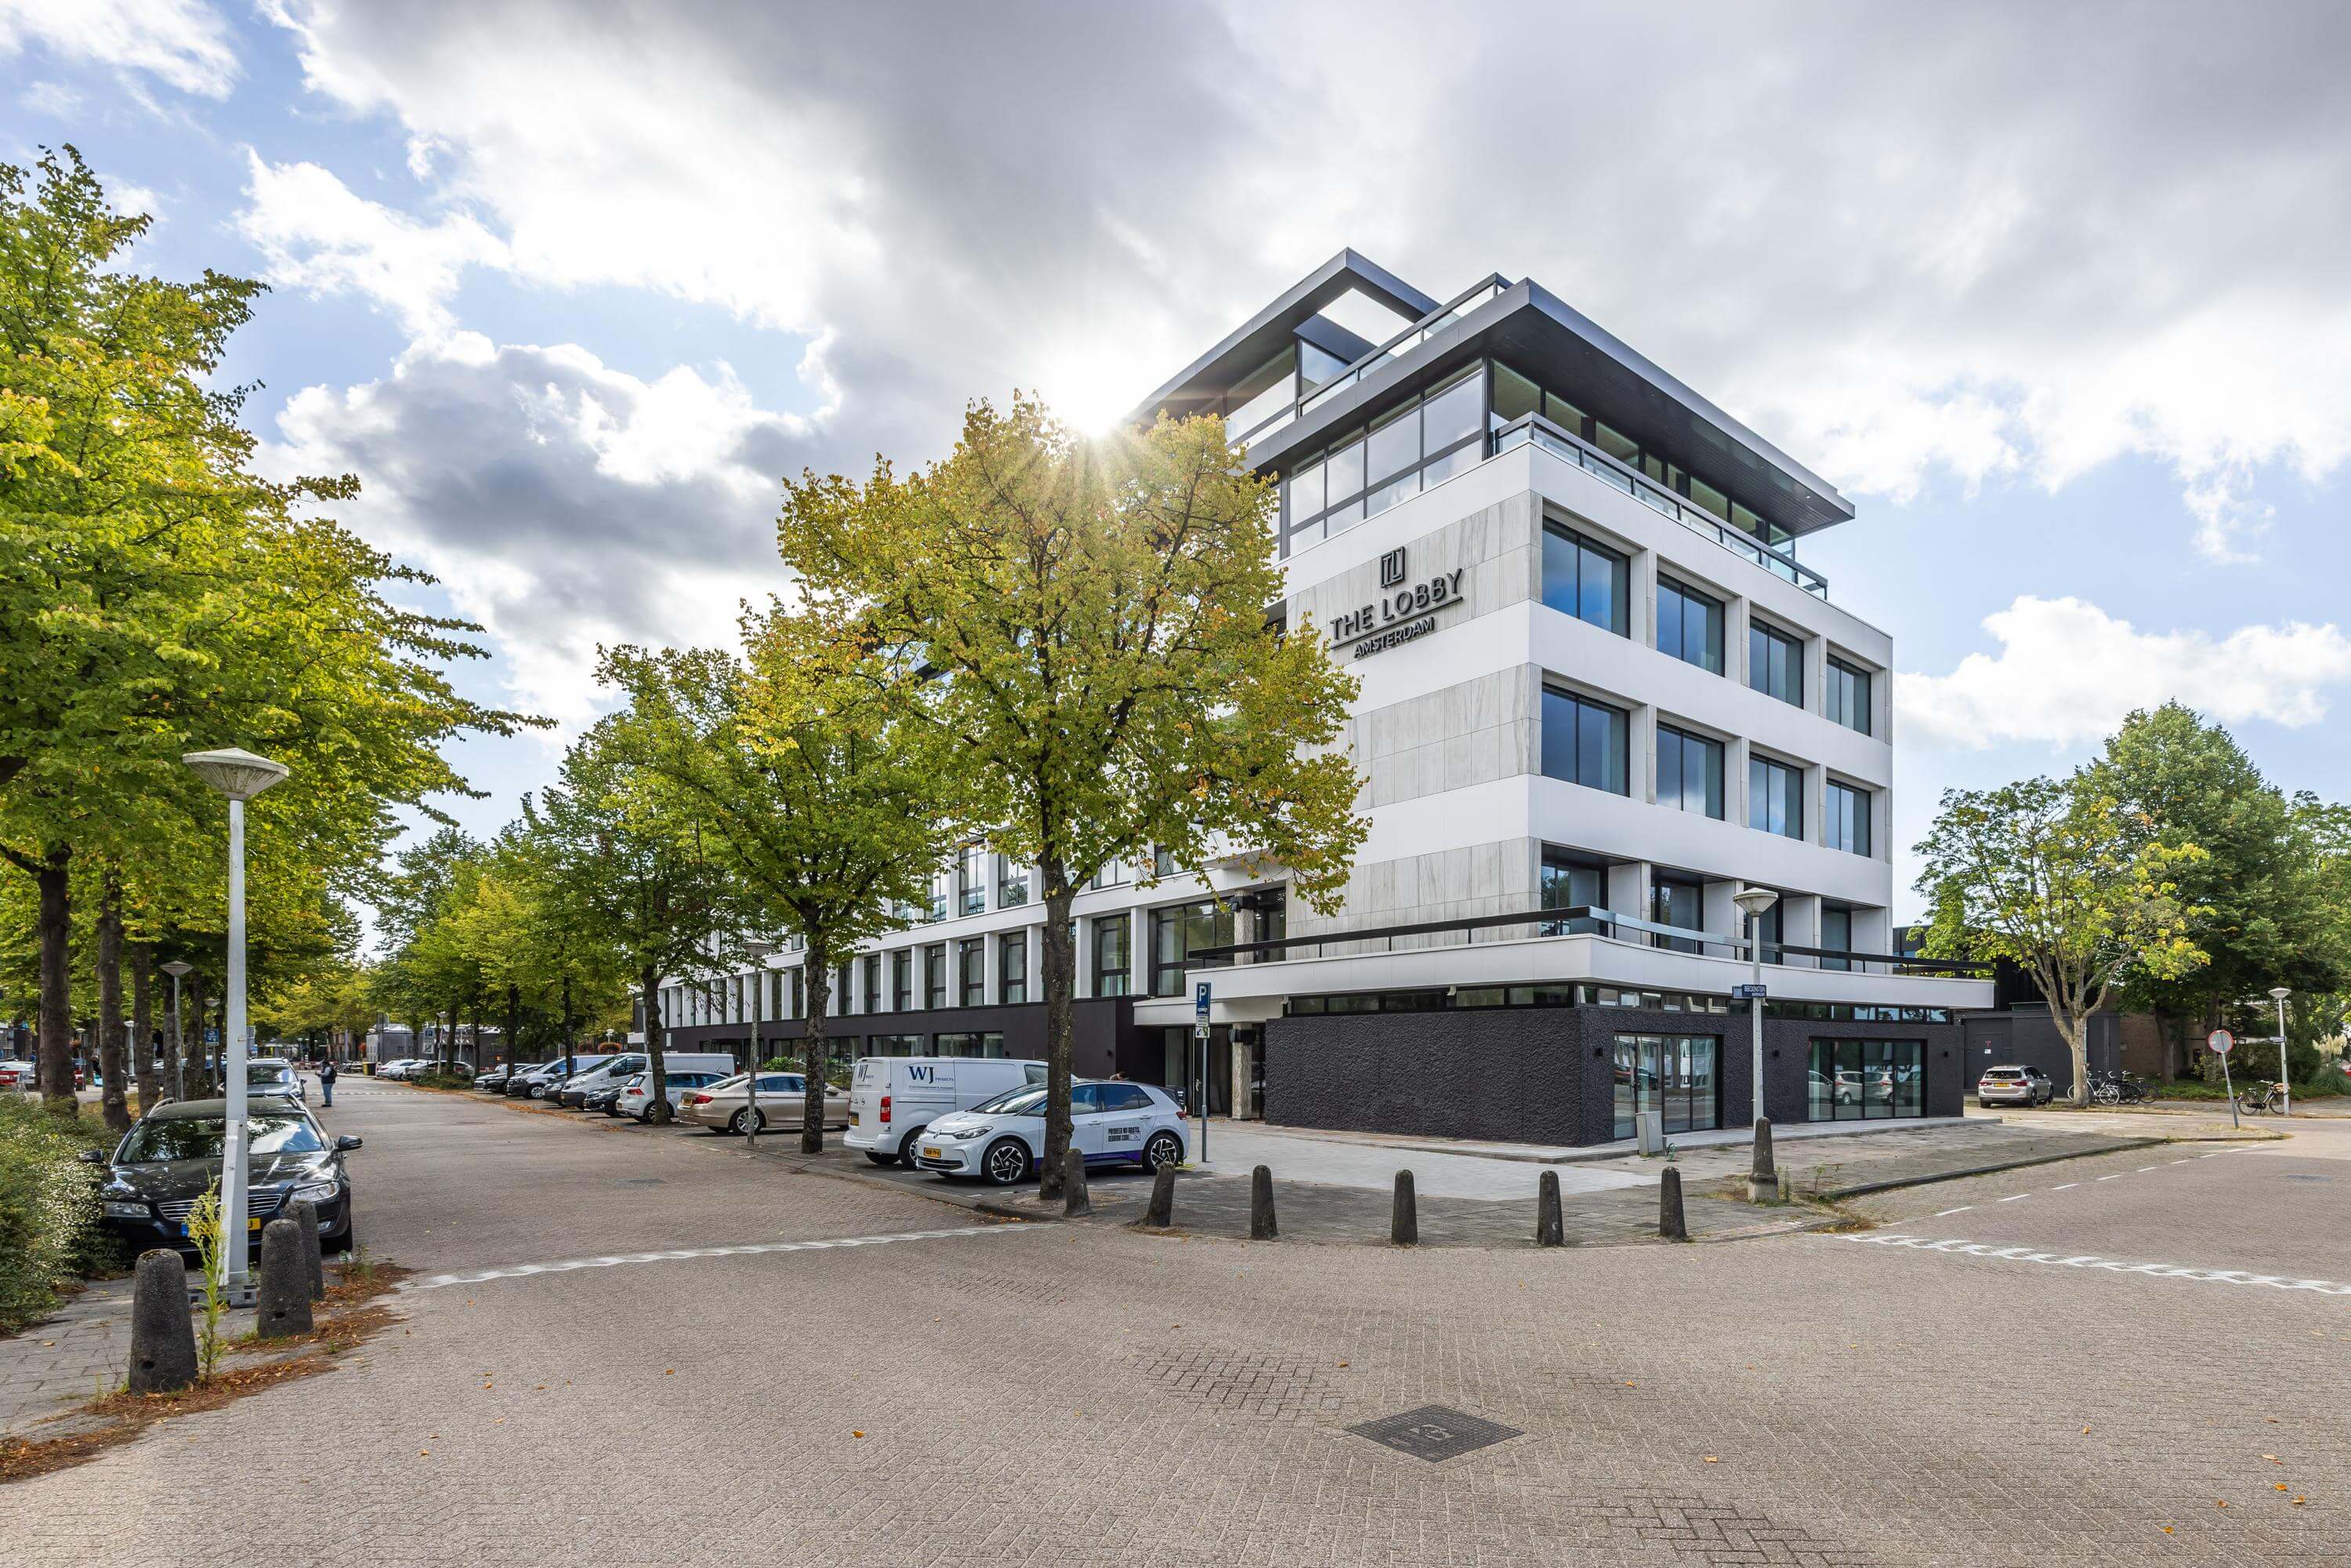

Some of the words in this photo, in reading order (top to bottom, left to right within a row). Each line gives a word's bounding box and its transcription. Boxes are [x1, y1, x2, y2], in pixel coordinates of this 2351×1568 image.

[1330, 605, 1375, 640] THE
[1382, 568, 1463, 621] LOBBY
[1354, 617, 1435, 658] AMSTERDAM
[1199, 985, 1207, 1002] P
[858, 1065, 868, 1082] WJ
[908, 1066, 934, 1084] WJ
